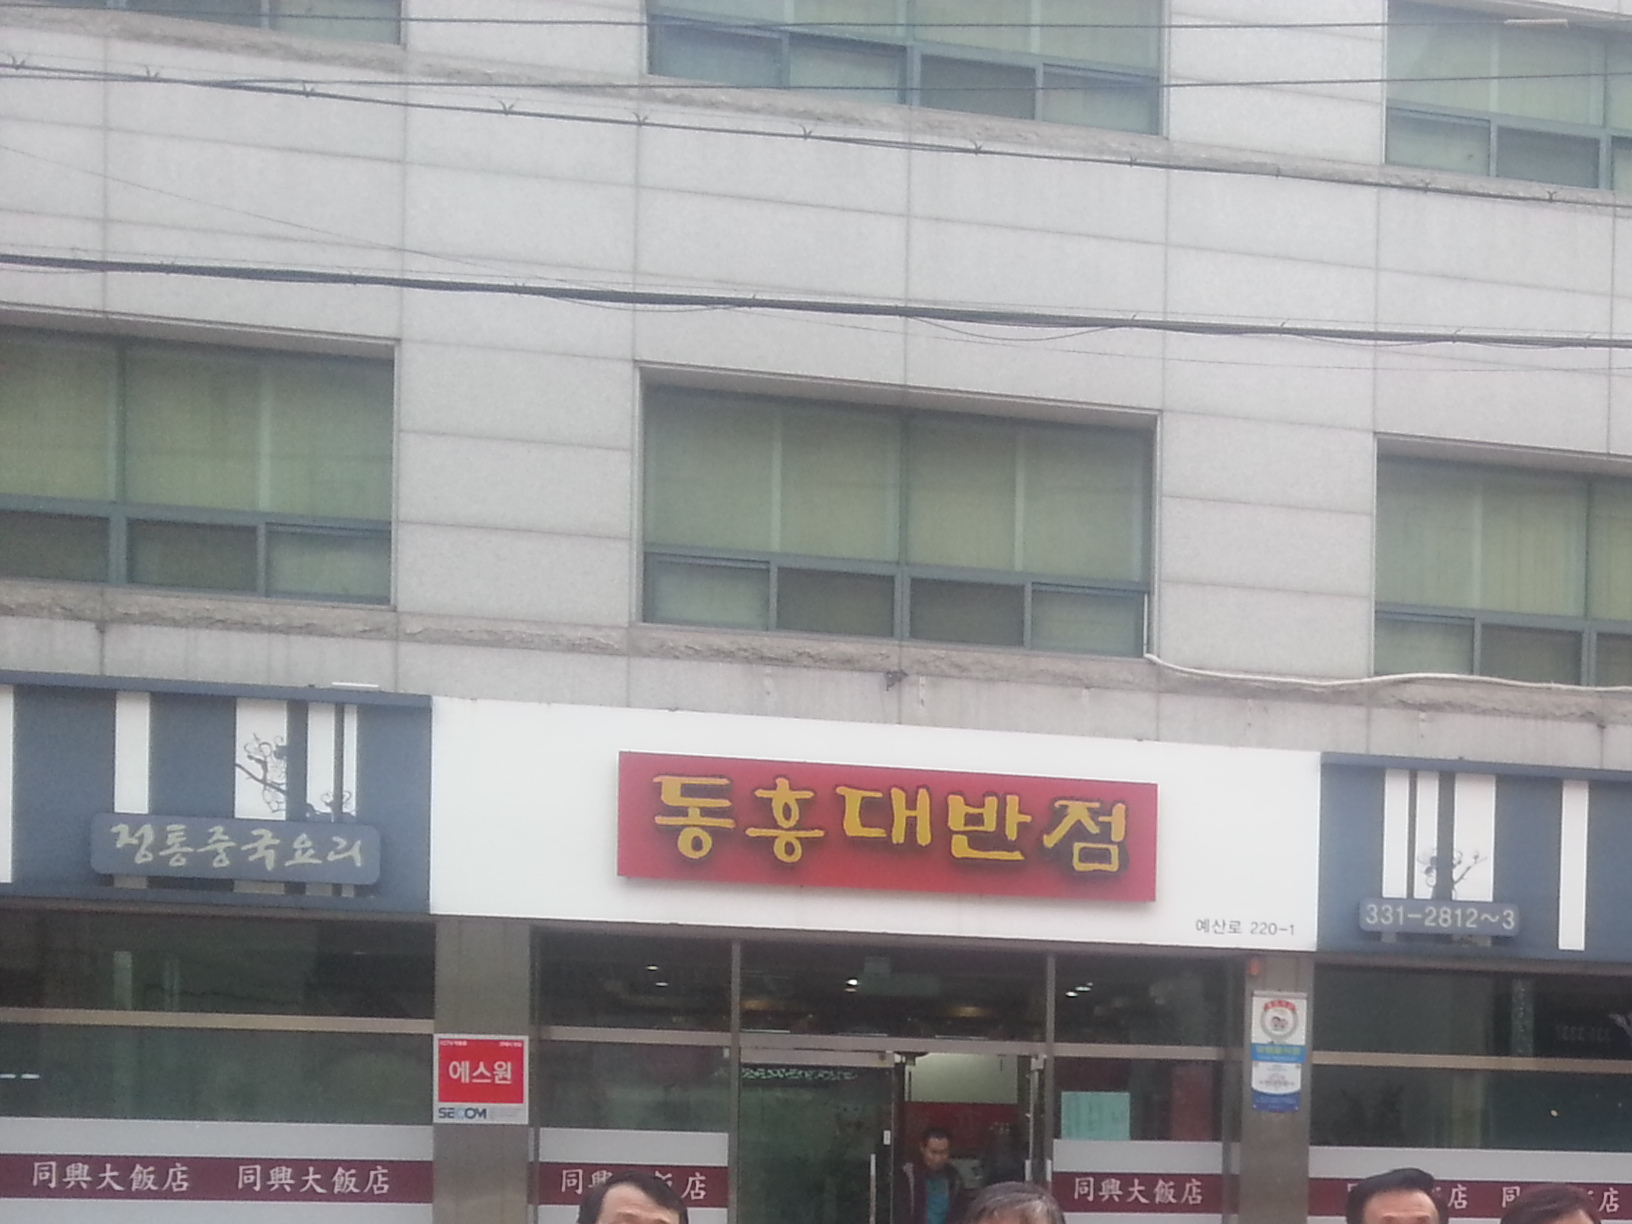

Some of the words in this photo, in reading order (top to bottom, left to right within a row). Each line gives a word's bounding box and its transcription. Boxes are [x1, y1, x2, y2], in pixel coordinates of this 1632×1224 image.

[653, 775, 1127, 872] 동흥대반점
[110, 823, 363, 872] 정통중국요리
[1195, 919, 1242, 935] 예산로
[1250, 921, 1294, 936] 220-1
[448, 1060, 512, 1085] 에스원
[438, 1107, 487, 1120] SECOM
[32, 1160, 190, 1192] 同興大飯店
[237, 1163, 391, 1195] 同興大飯店
[560, 1168, 707, 1201] 同興店
[1073, 1176, 1203, 1205] 同興大飯店
